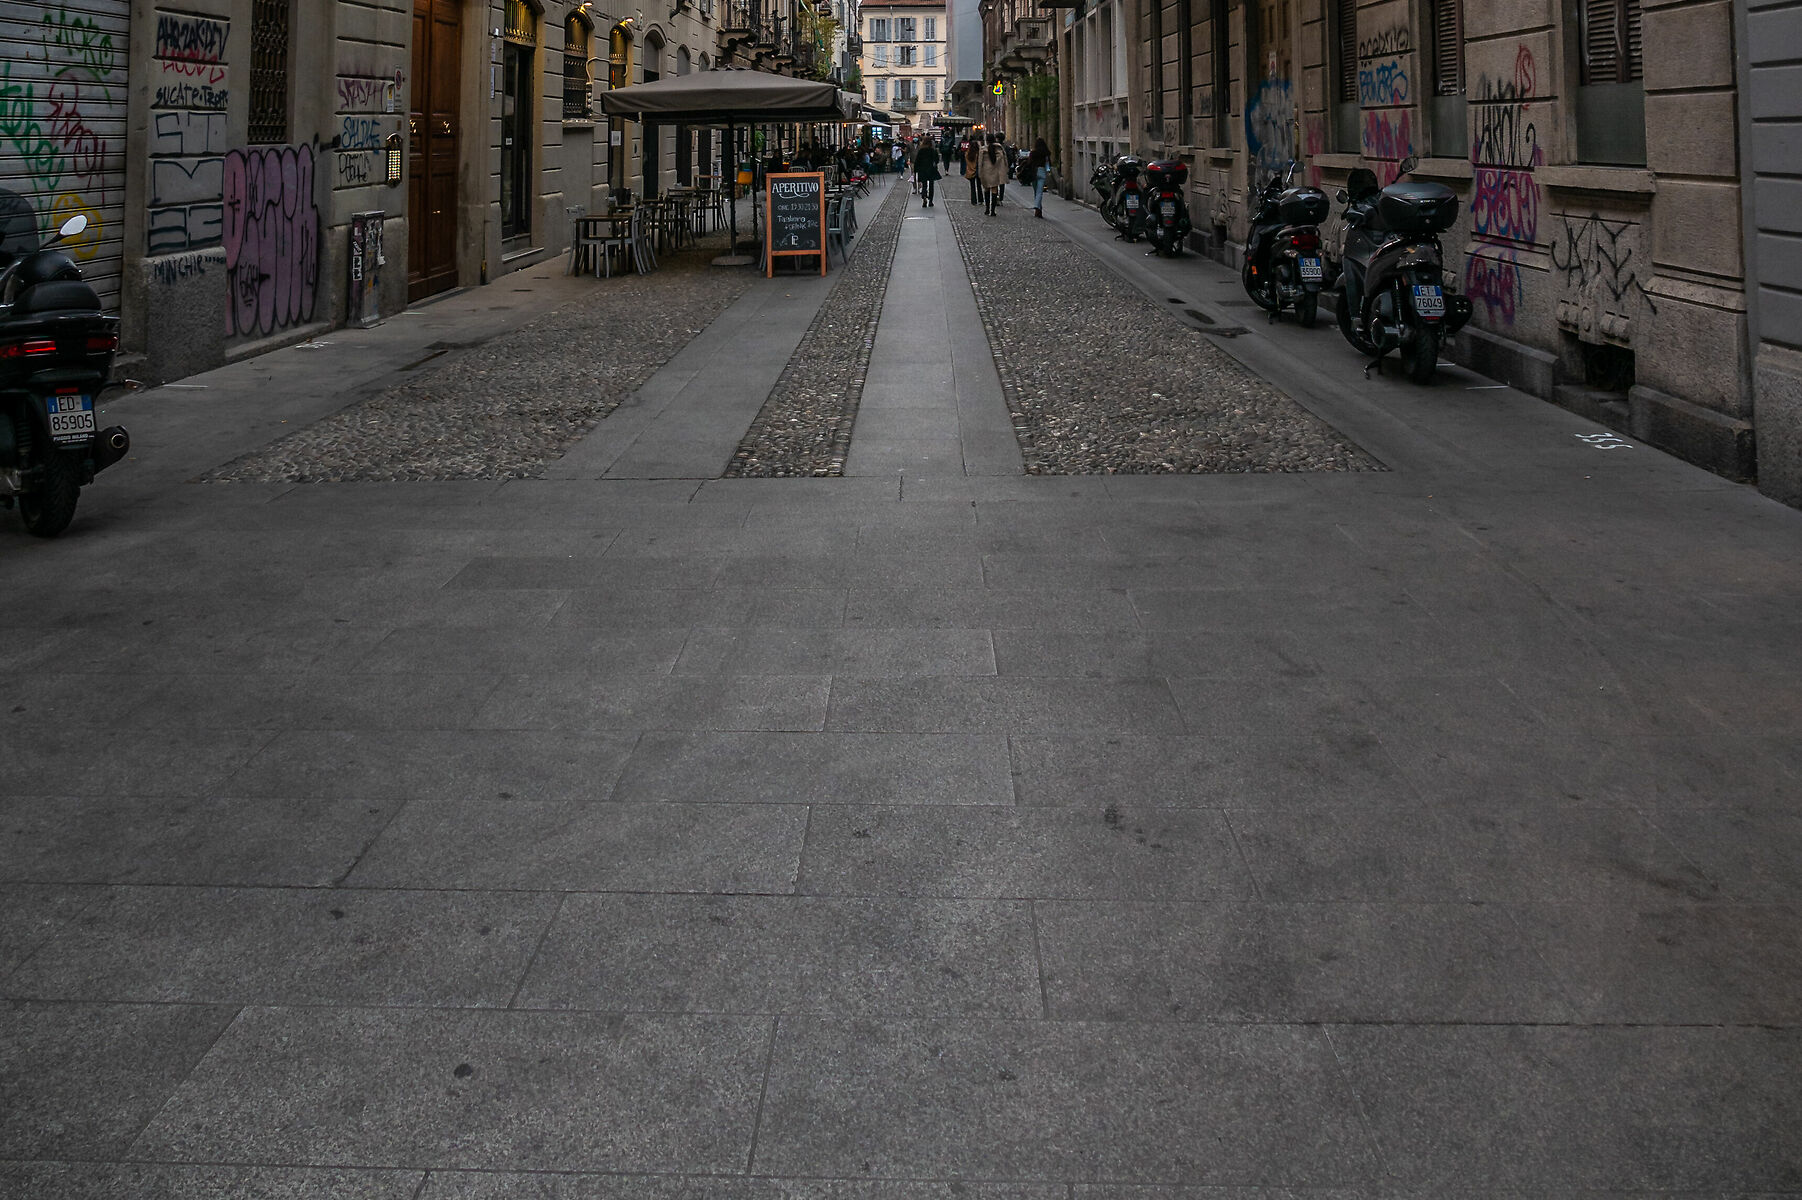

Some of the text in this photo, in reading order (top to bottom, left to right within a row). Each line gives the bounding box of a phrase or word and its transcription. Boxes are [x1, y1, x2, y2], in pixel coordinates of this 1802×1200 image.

[771, 182, 819, 199] APERITIVO
[1416, 298, 1443, 308] 76049
[58, 396, 75, 412] ED
[52, 413, 93, 431] 85905
